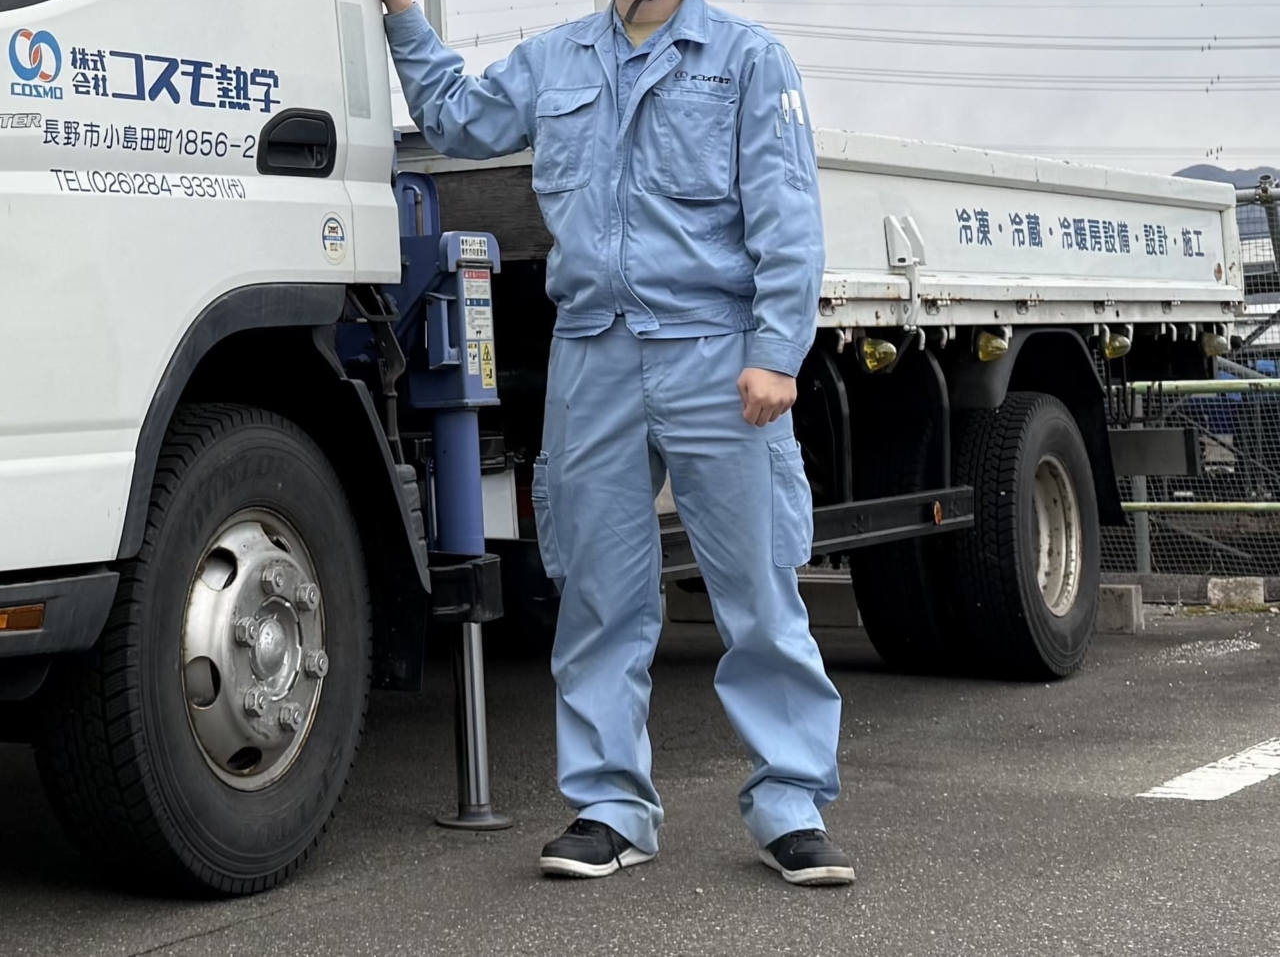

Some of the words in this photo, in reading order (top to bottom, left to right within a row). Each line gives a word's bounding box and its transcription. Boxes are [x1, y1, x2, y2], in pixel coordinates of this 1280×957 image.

[11, 82, 64, 100] COSMO
[43, 119, 257, 160] 長野市小島田町1856-2
